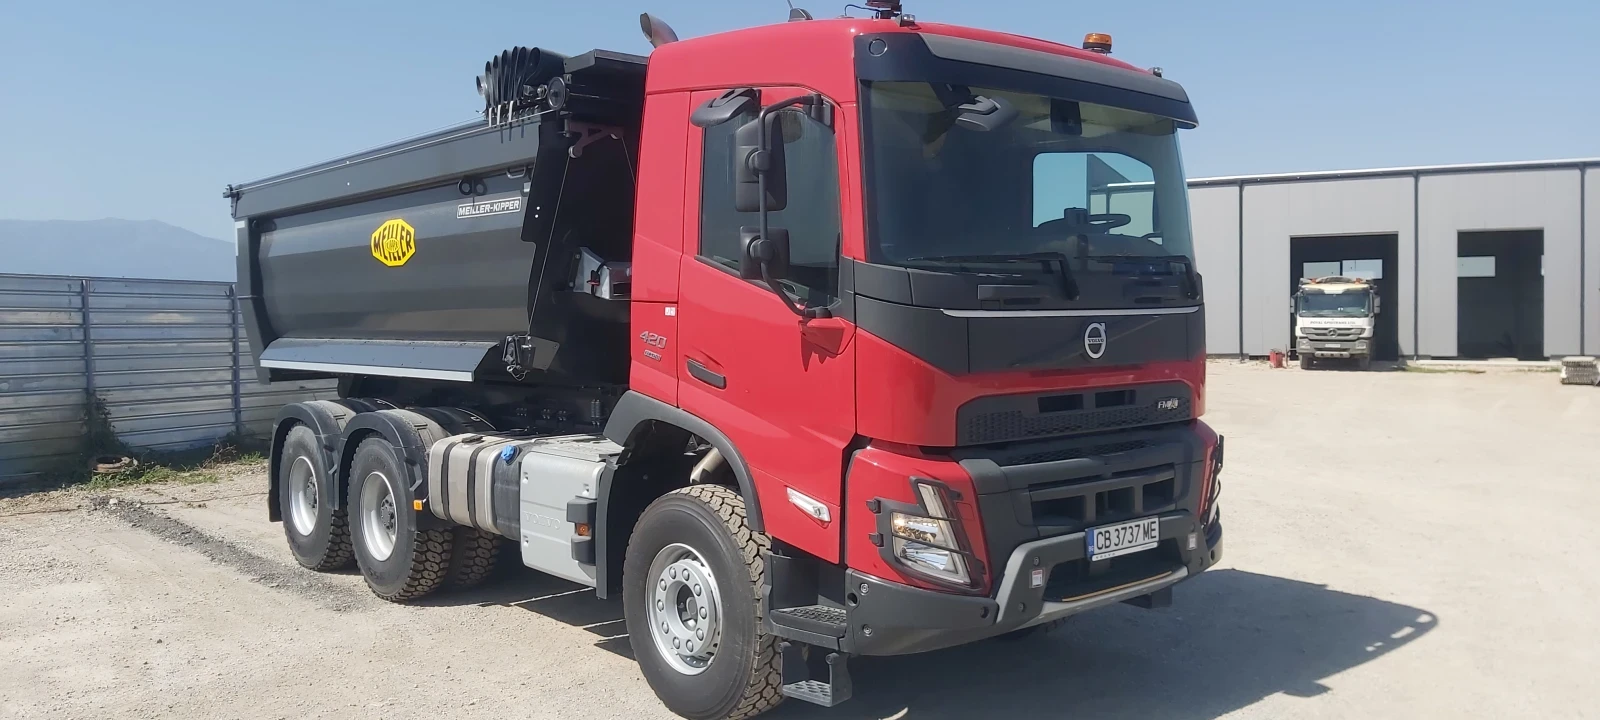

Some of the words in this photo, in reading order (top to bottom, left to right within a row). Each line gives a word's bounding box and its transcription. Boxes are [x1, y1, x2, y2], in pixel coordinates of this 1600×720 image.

[458, 200, 520, 216] MEILLER-KIPPER
[373, 223, 413, 262] MEILLER
[640, 330, 667, 349] 420
[523, 511, 561, 530] VOLVO
[1096, 530, 1111, 550] CB
[1114, 524, 1140, 547] 3737
[1142, 521, 1156, 541] ME
